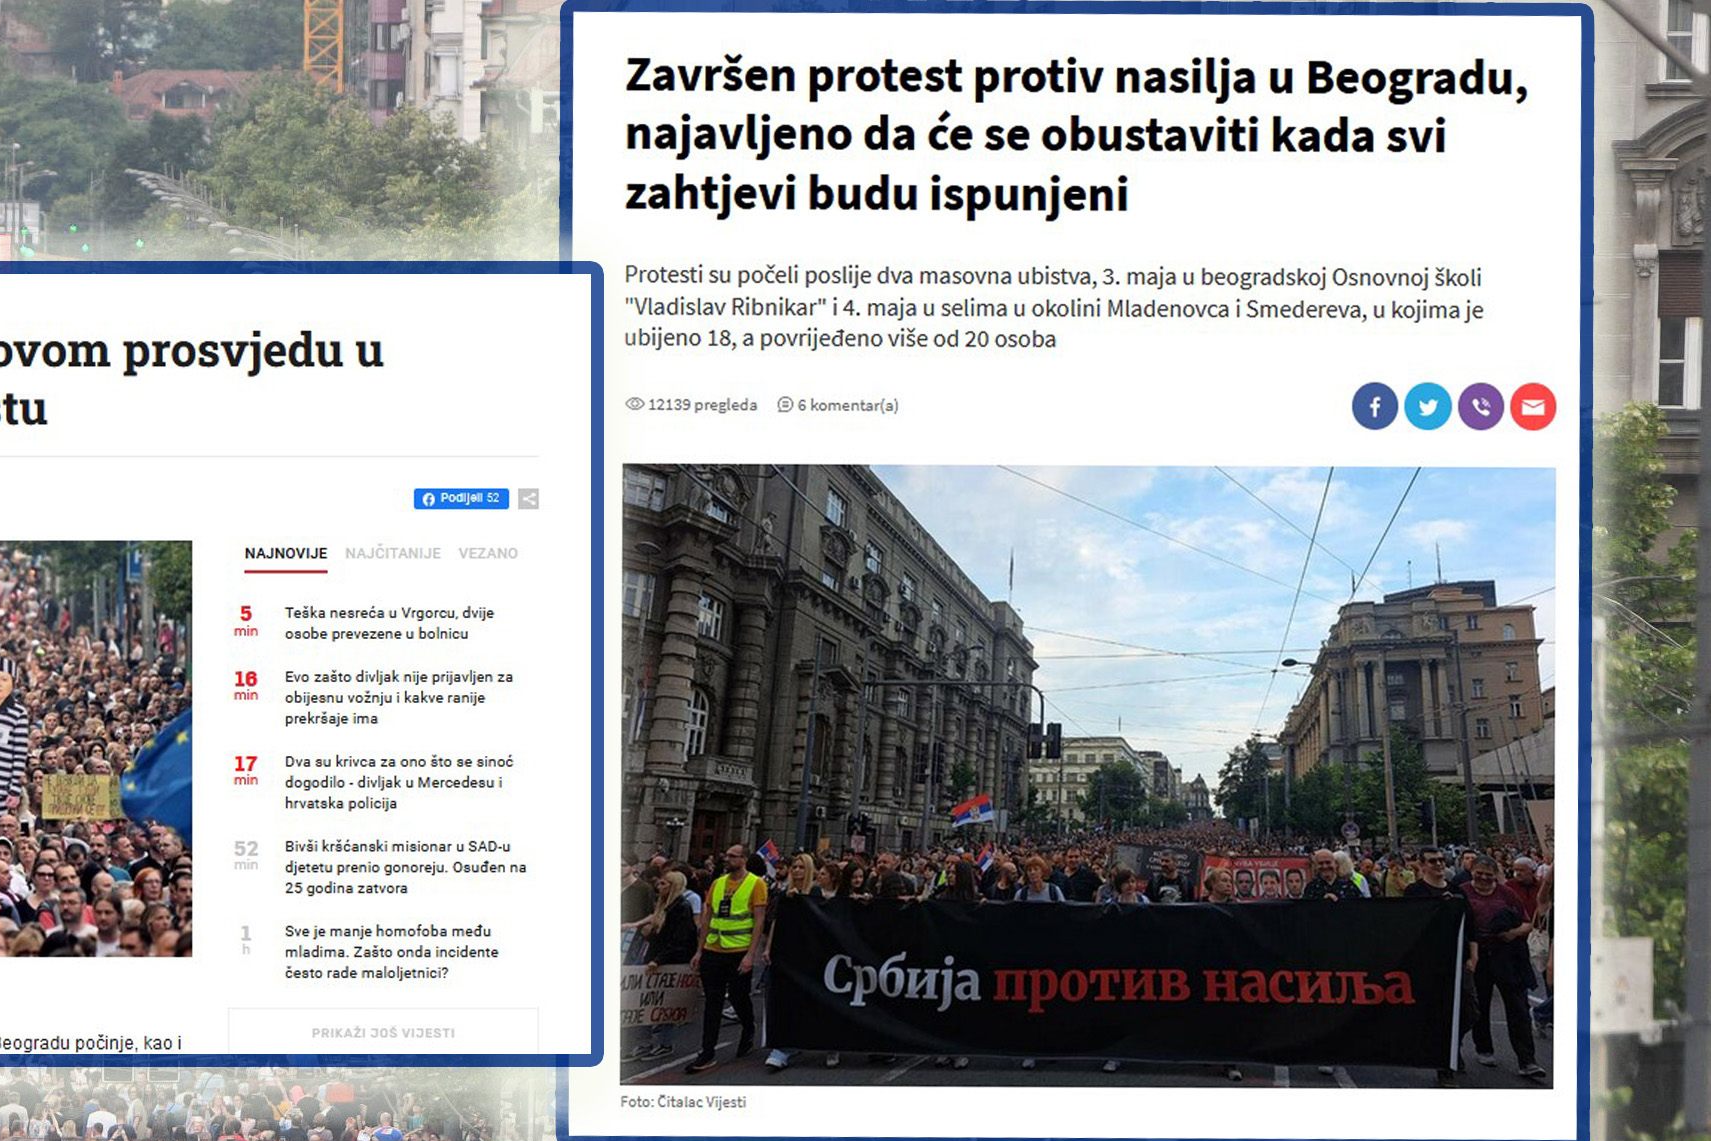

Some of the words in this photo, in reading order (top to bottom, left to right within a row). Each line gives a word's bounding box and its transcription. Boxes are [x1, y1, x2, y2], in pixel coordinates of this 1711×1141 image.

[824, 951, 980, 1012] Србија
[994, 968, 1191, 1013] против
[1202, 968, 1416, 1005] насиља
